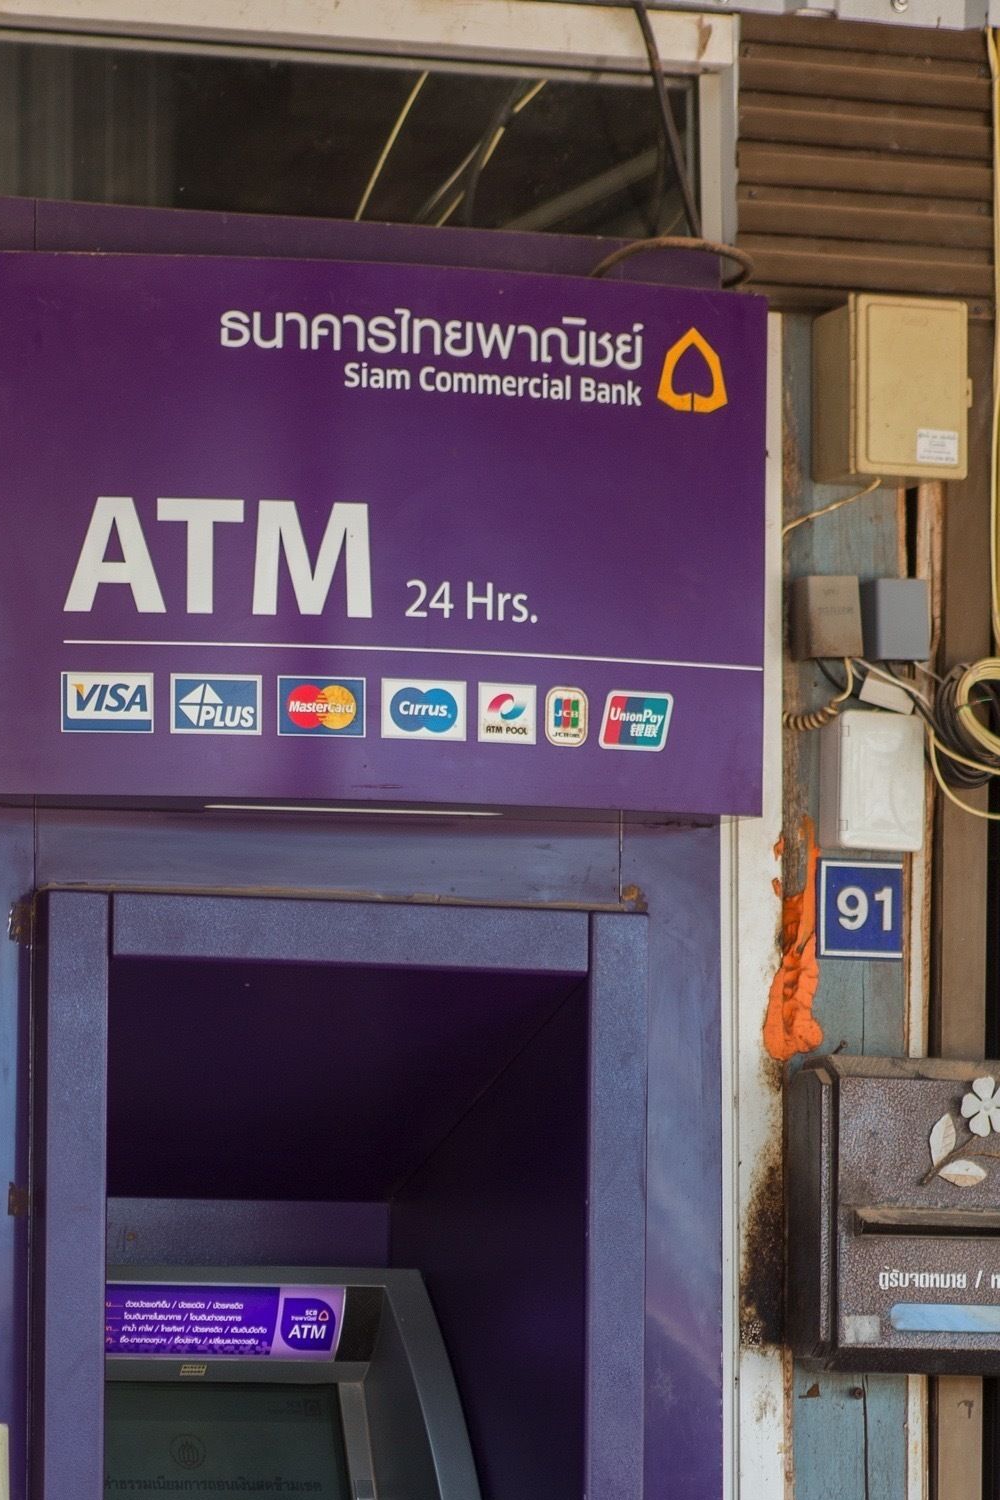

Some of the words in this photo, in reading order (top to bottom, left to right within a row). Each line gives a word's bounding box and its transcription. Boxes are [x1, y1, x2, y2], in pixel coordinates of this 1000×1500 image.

[220, 308, 643, 371] ธนาคารไทยพาณิชย์
[344, 361, 410, 391] Siam
[418, 366, 572, 402] Commercial
[579, 375, 642, 407] Bank
[63, 496, 373, 618] ATM
[405, 579, 455, 620] 24
[466, 582, 539, 624] Hrs.
[72, 683, 148, 713] VISA
[288, 700, 355, 715] MasterCard
[398, 700, 448, 717] Cirrus
[199, 704, 255, 728] PLUS
[554, 709, 578, 718] JCB
[609, 706, 664, 728] UnionPay
[486, 725, 503, 735] ATM
[506, 726, 528, 736] POOL
[837, 886, 893, 931] 91
[878, 1266, 967, 1289] ตู้รับจดหมาย
[288, 1324, 327, 1339] ATM
